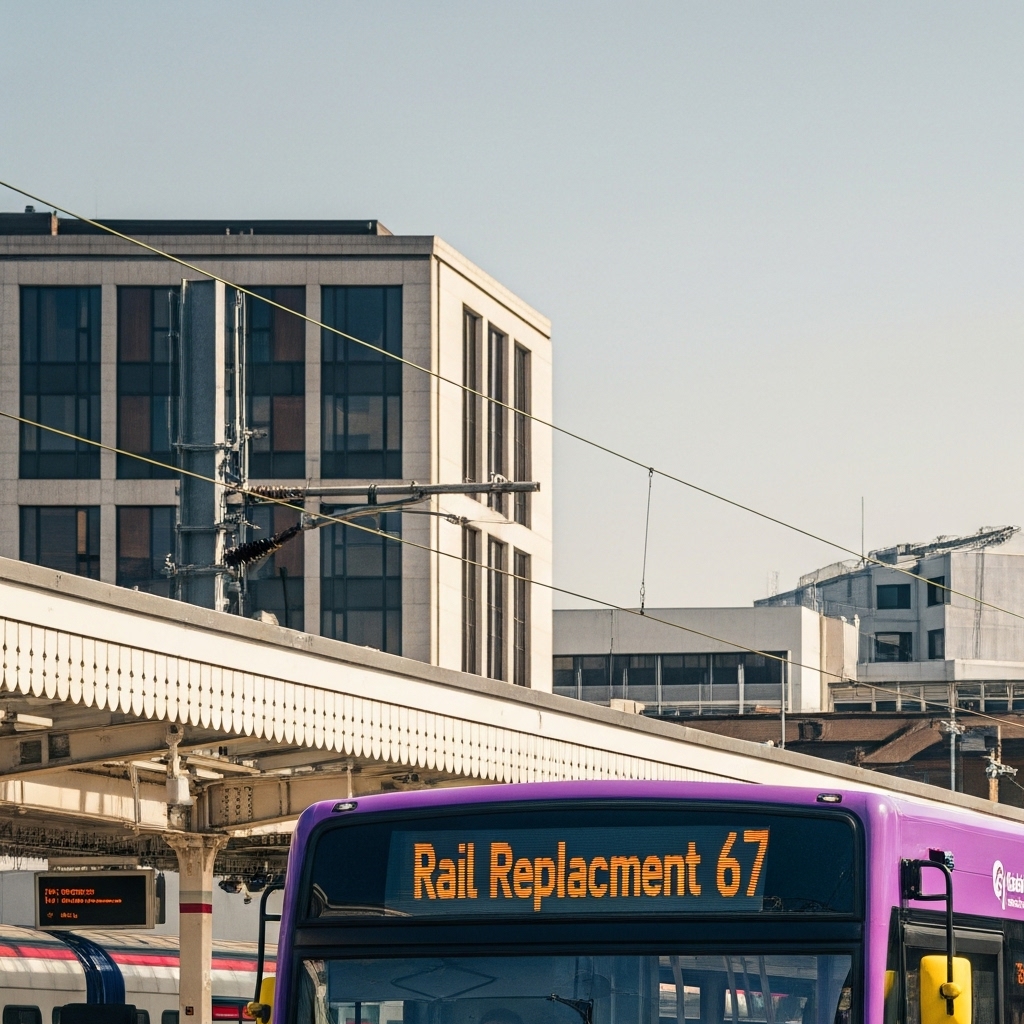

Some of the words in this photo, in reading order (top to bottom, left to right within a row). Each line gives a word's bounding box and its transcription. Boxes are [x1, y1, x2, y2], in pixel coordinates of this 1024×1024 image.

[413, 842, 478, 901] Rail
[489, 840, 702, 913] Replacment
[716, 829, 770, 899] 67
